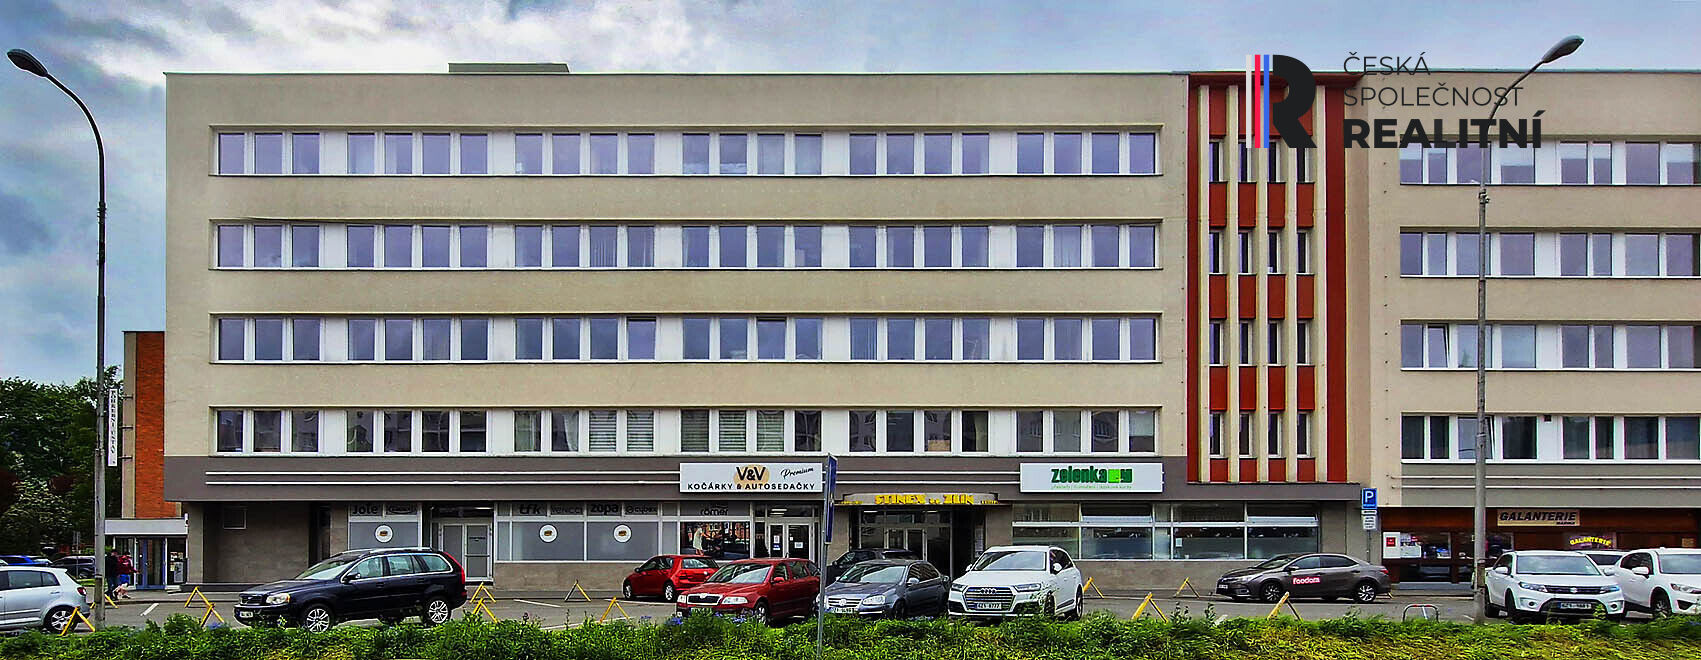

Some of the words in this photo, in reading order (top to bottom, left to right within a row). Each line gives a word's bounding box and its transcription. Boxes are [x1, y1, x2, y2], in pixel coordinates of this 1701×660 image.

[736, 466, 766, 481] V&V
[780, 467, 814, 480] Premium
[687, 481, 733, 490] KOČÁRKY
[744, 481, 815, 490] AUTOSEDAČKY
[1365, 490, 1374, 503] P
[590, 503, 619, 516] zopa
[1500, 512, 1576, 521] GALANTERIE
[1569, 536, 1612, 547] GALANTERIE
